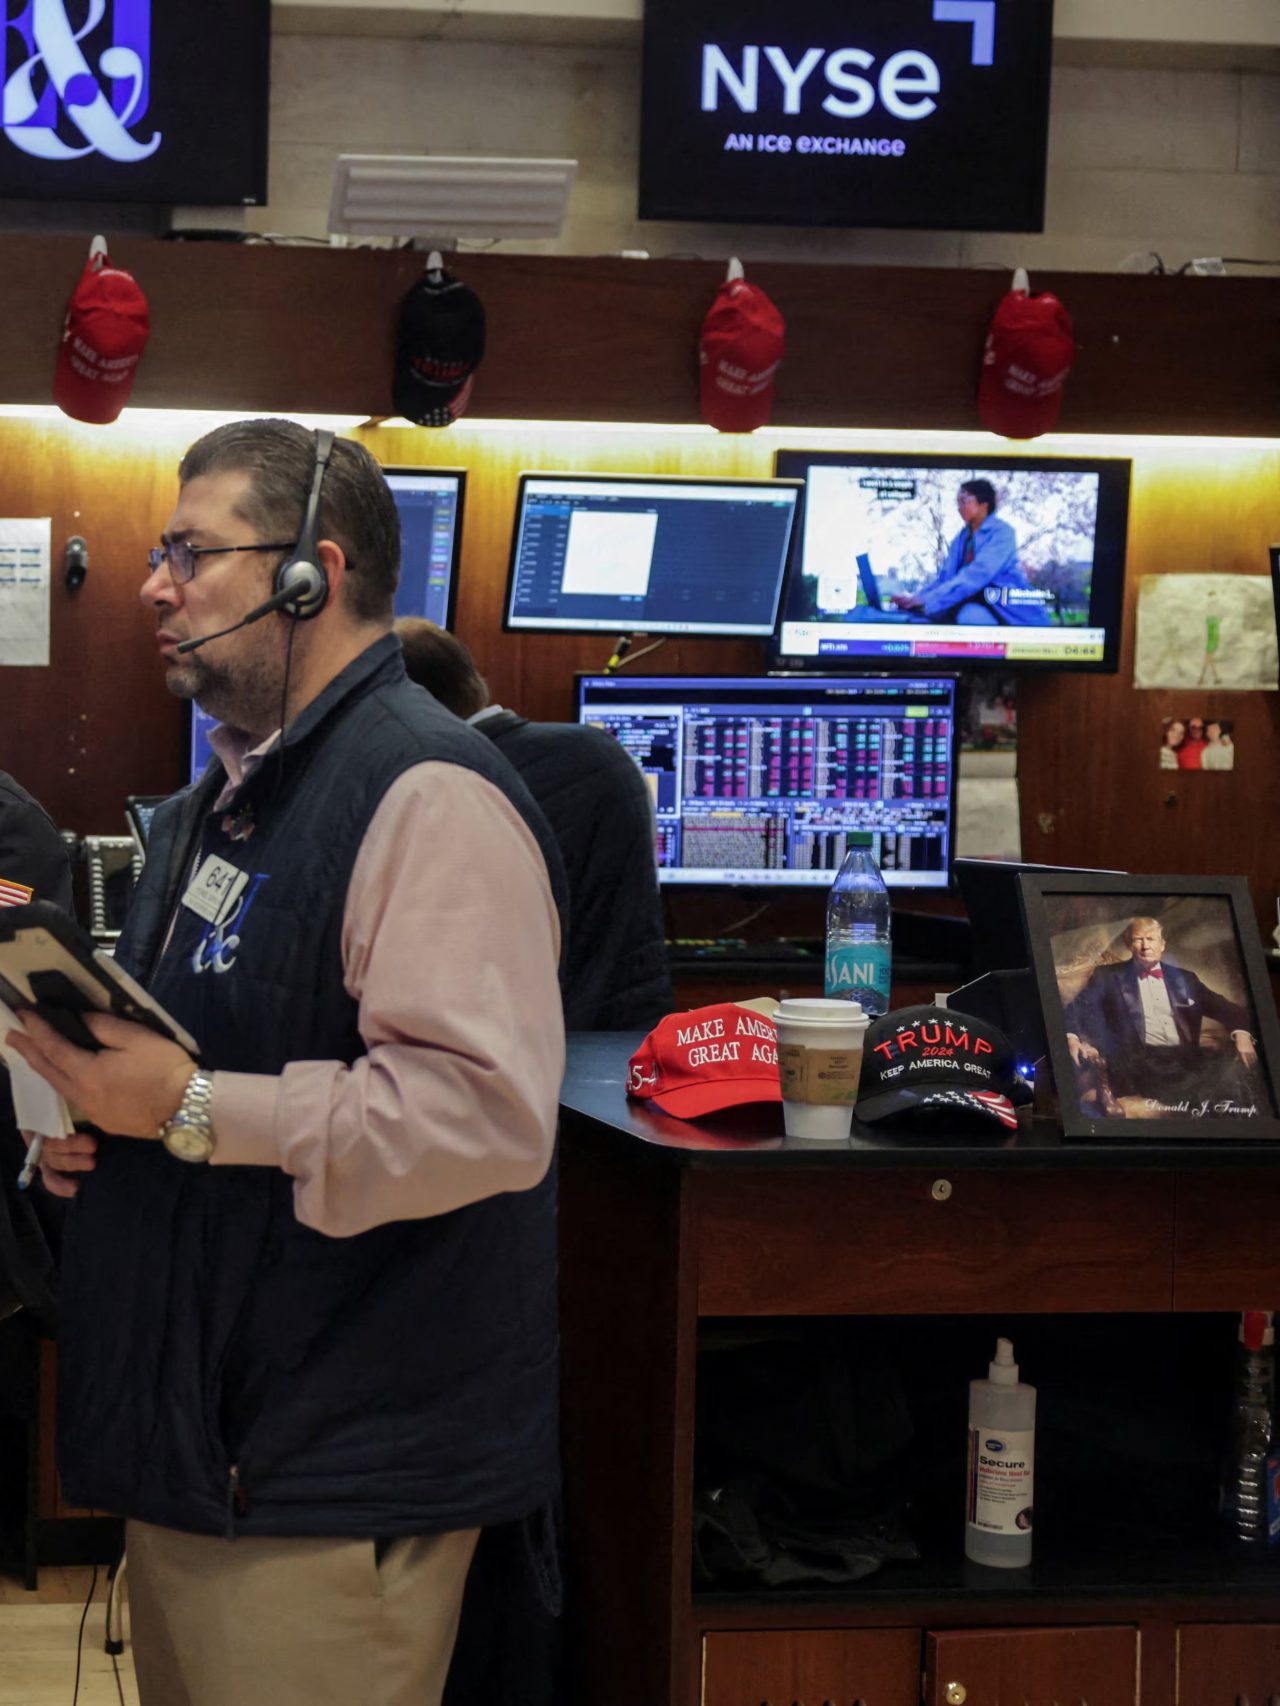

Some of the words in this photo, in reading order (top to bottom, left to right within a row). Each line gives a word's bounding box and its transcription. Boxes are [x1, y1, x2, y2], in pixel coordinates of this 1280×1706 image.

[724, 133, 753, 151] AN
[677, 1018, 725, 1046] MAKE
[873, 1024, 993, 1060] TRUMP
[688, 1042, 740, 1067] GREAT
[921, 1046, 955, 1057] 2024
[880, 1065, 905, 1081] KEEP
[909, 1058, 960, 1071] AMERICA
[964, 1062, 992, 1079] GREAT
[1144, 1098, 1190, 1113] Donald
[1214, 1100, 1257, 1118] Trump
[979, 1456, 1025, 1468] Secure
